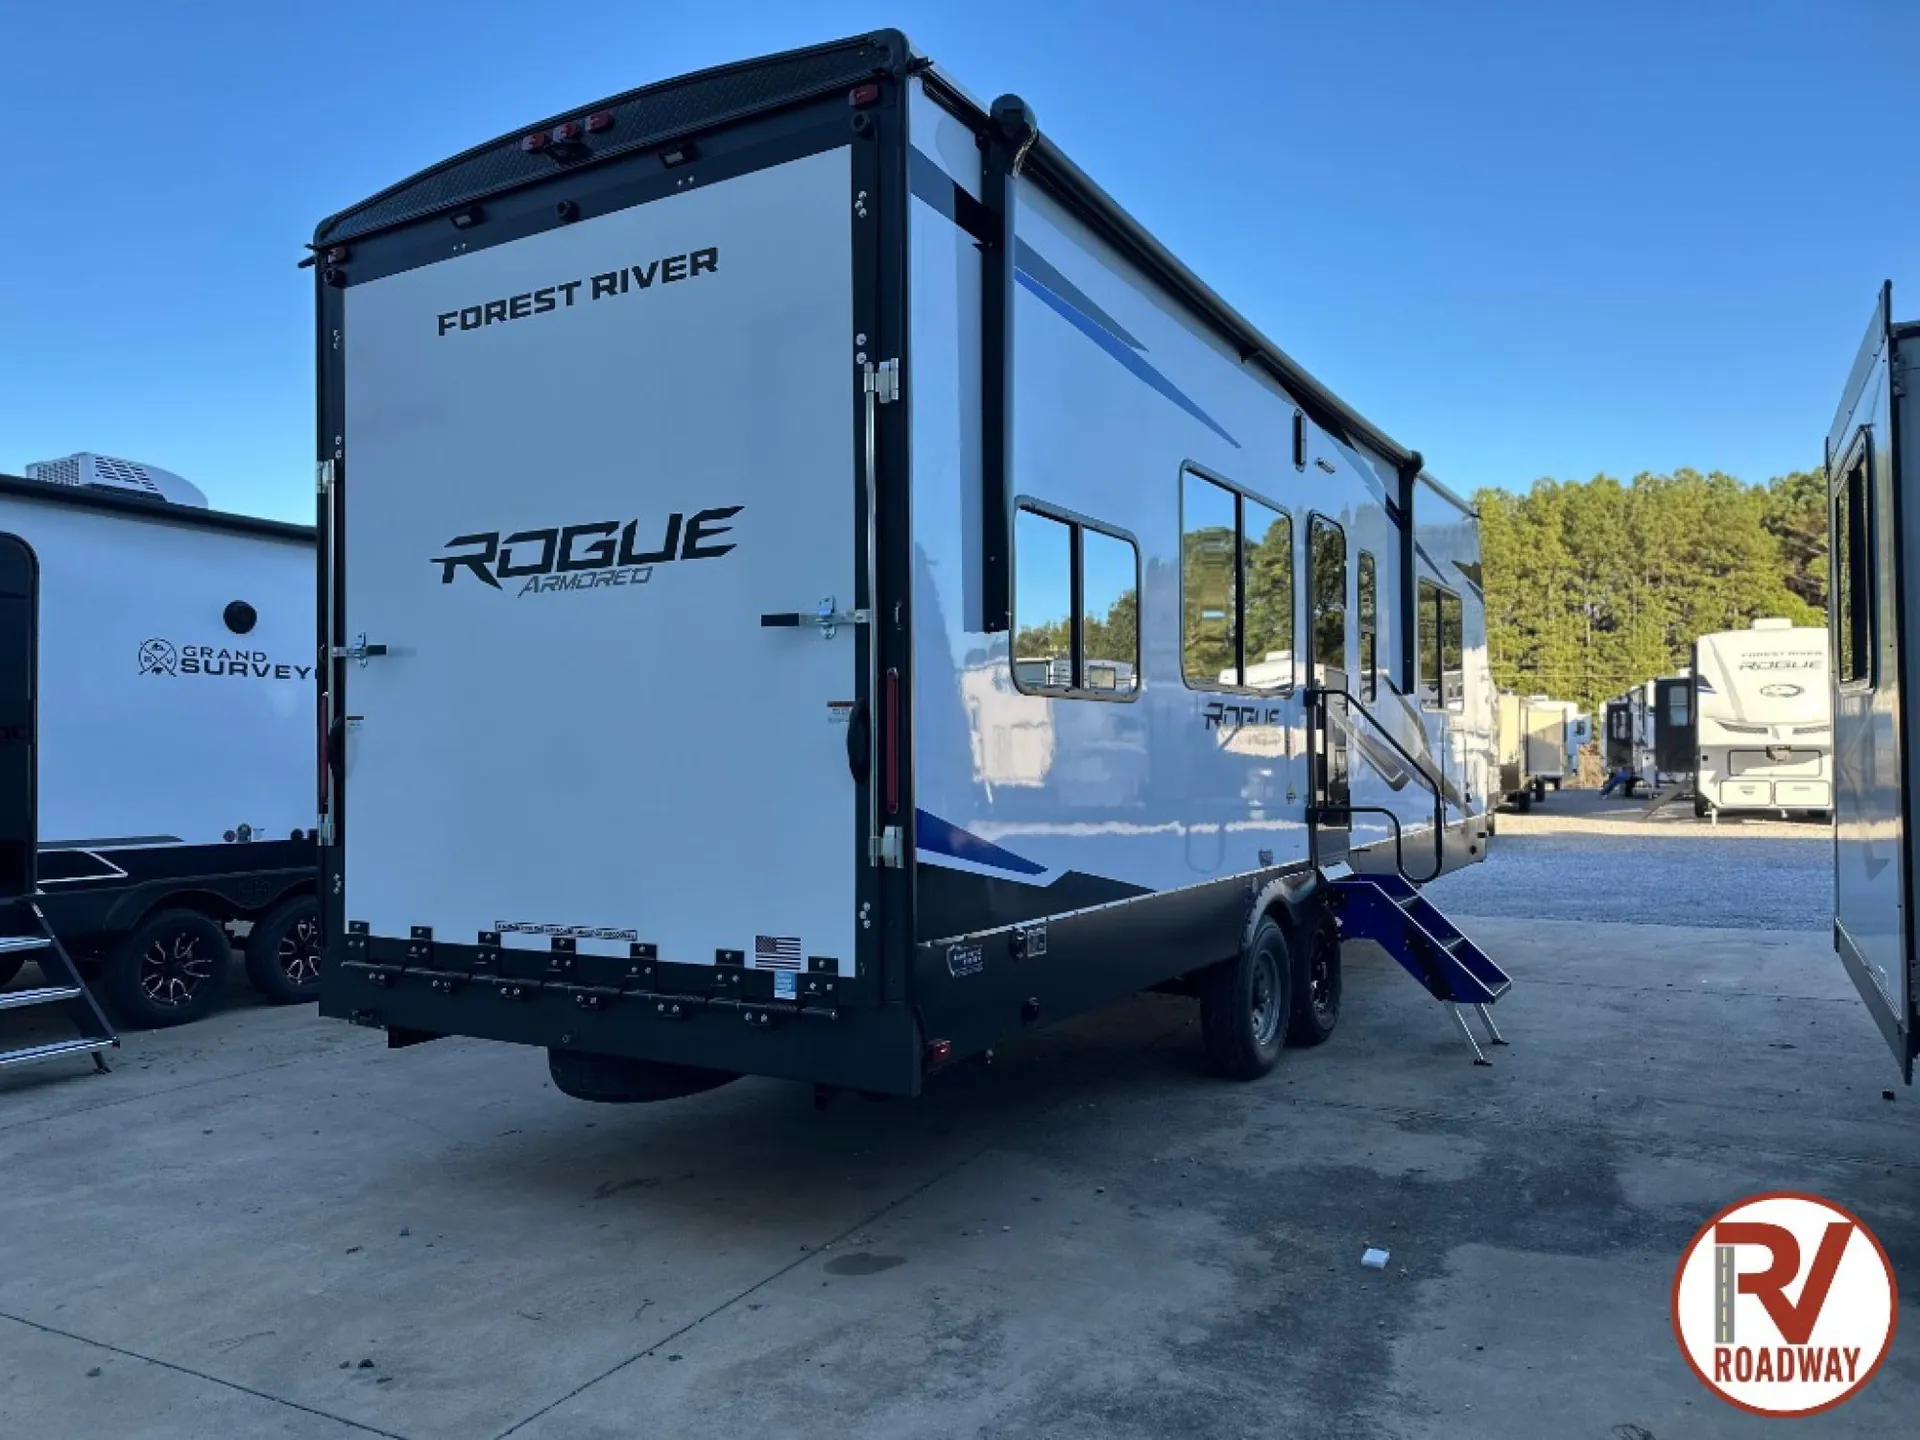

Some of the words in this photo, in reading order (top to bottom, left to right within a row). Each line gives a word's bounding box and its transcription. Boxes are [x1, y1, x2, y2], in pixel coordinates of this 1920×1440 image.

[437, 280, 582, 336] FOREST
[590, 247, 719, 300] RIVER
[429, 505, 745, 591] ROGUE
[517, 565, 653, 598] ARMORED
[180, 658, 317, 680] SURVEY
[182, 645, 267, 663] GRAND
